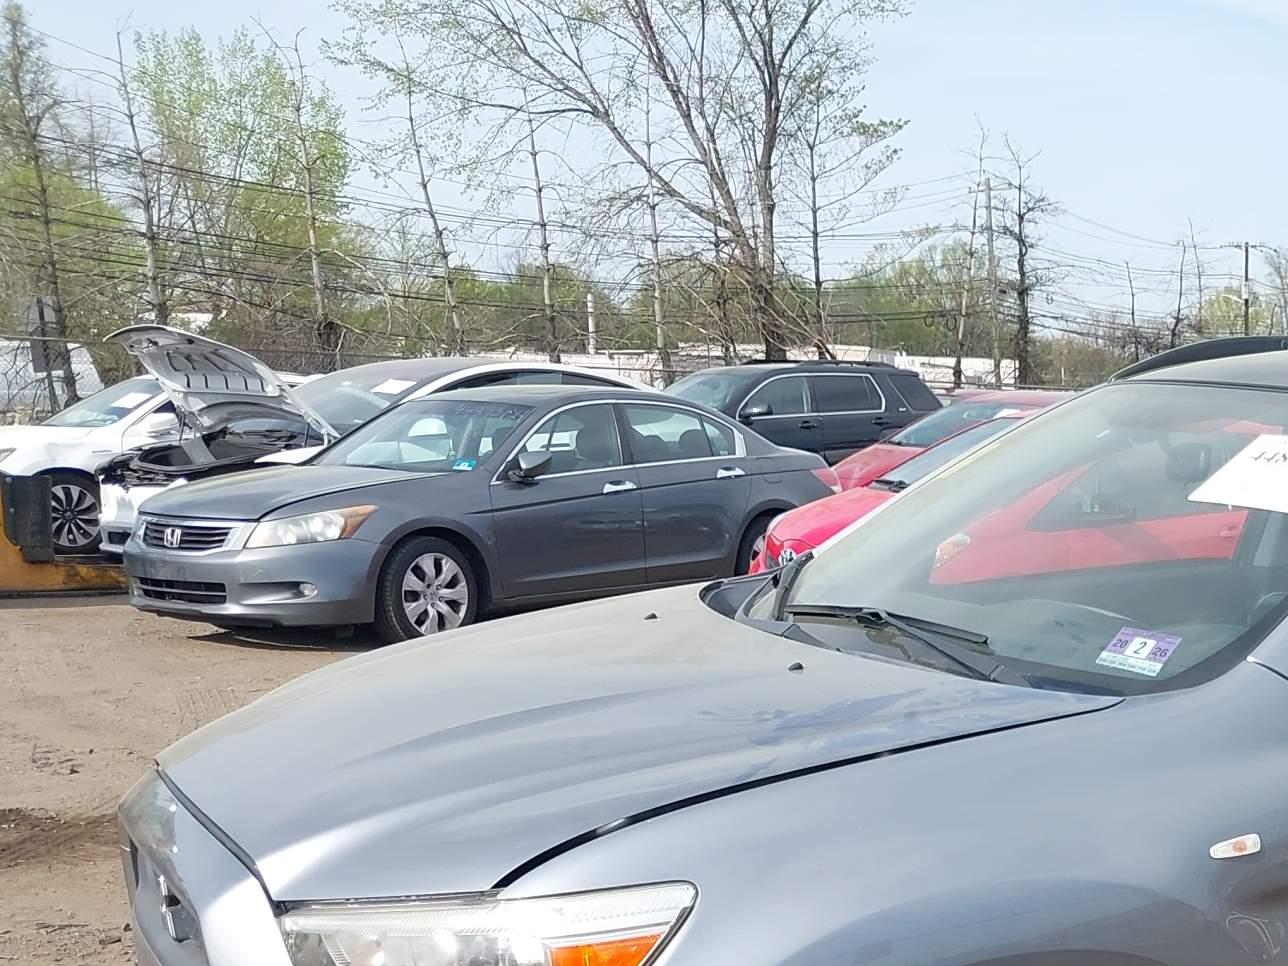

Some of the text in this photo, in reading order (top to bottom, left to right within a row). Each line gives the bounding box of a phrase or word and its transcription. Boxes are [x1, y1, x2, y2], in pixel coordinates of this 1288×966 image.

[1112, 639, 1169, 658] 20 2 26
